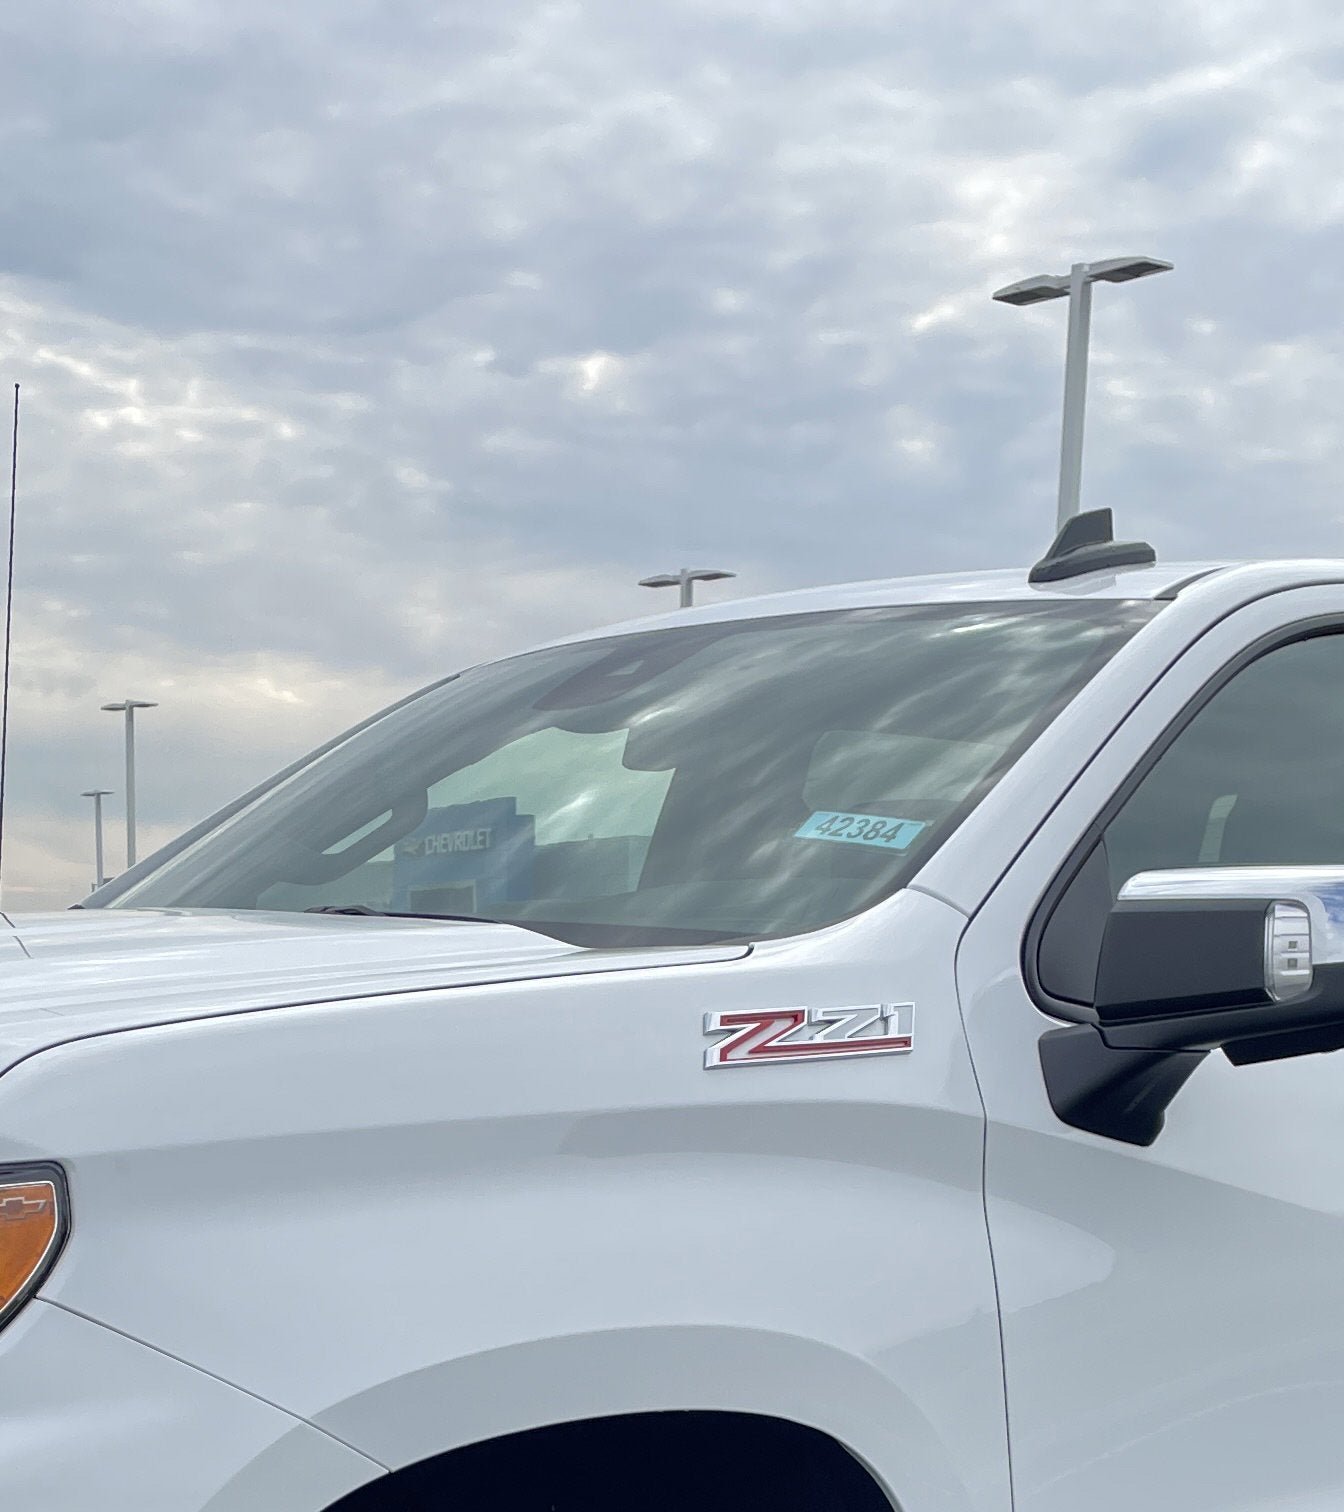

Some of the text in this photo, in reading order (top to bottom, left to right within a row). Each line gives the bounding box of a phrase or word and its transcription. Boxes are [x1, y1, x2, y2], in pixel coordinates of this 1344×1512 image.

[424, 828, 492, 856] CHEVROLET
[815, 815, 904, 843] 42384
[703, 1001, 916, 1071] Z71
